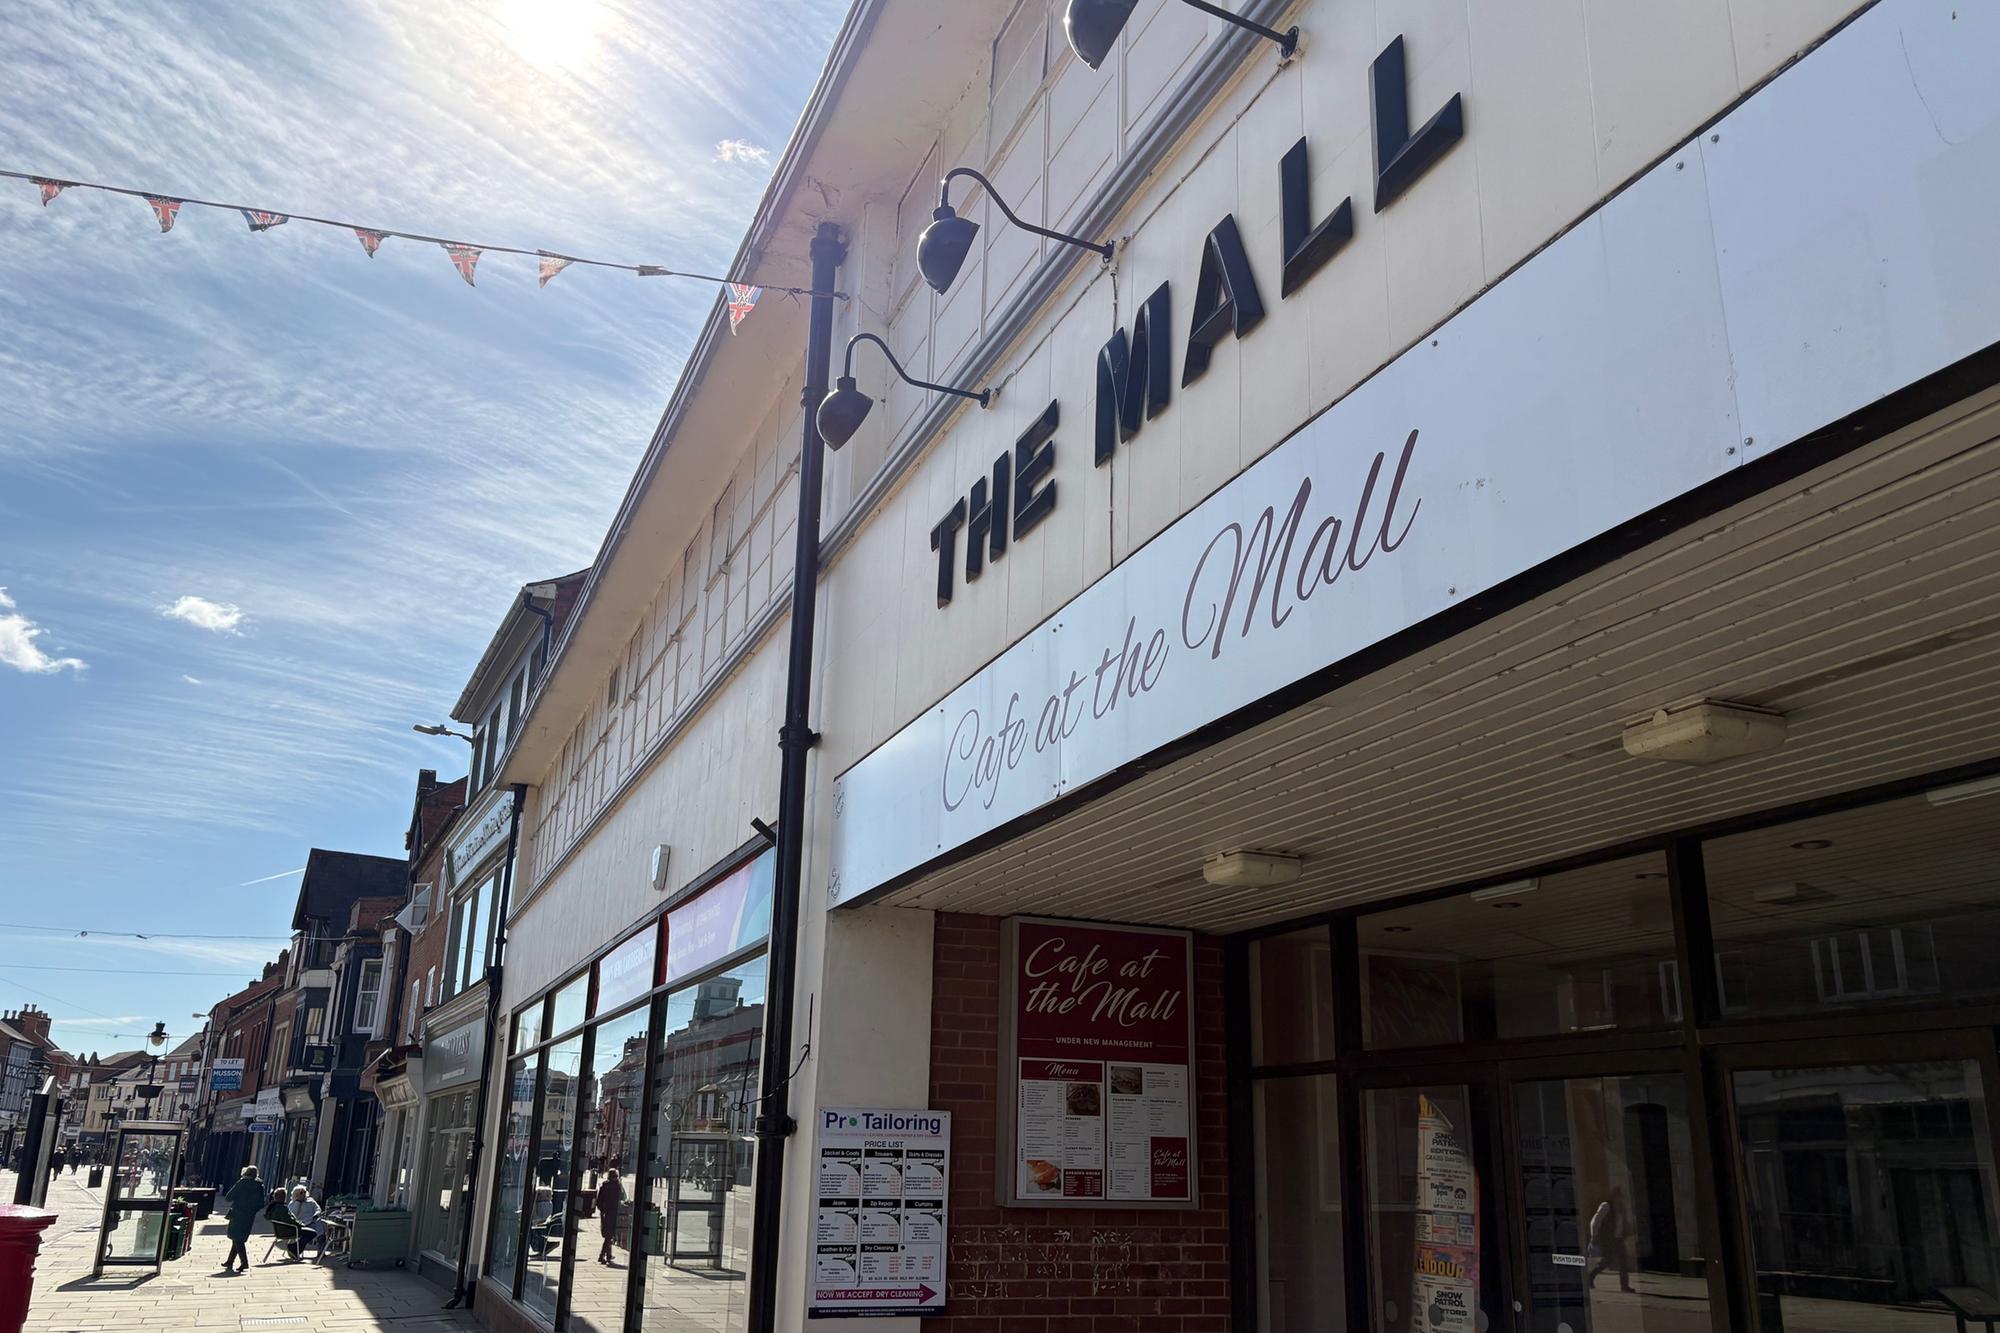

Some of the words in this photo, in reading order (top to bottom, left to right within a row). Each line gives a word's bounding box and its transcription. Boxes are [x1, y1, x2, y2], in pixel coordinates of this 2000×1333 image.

[930, 398, 1059, 609] THE
[1094, 34, 1464, 468] MALL
[942, 692, 1029, 812] Cafe
[1035, 670, 1087, 754] at
[1092, 616, 1170, 721] the
[1182, 429, 1422, 660] Mall
[1025, 937, 1109, 993] Cafe
[1120, 949, 1172, 978] at
[1025, 981, 1078, 1014] the
[1078, 981, 1181, 1027] Mall
[1055, 1036, 1082, 1045] UNDER
[1083, 1038, 1100, 1046] NEW
[1102, 1039, 1153, 1048] MANAGEMENT
[212, 1069, 241, 1077] MUSSON
[1044, 1062, 1080, 1077] Menu
[862, 1112, 941, 1135] Tailoring
[864, 1140, 887, 1148] PRICE
[816, 1290, 834, 1299] NOW
[835, 1290, 845, 1299] WE
[847, 1290, 873, 1298] ACCEPT
[875, 1290, 889, 1298] DRY
[890, 1290, 924, 1298] CLEANING
[1436, 1290, 1463, 1300] SNOW
[1434, 1297, 1466, 1308] PATROL
